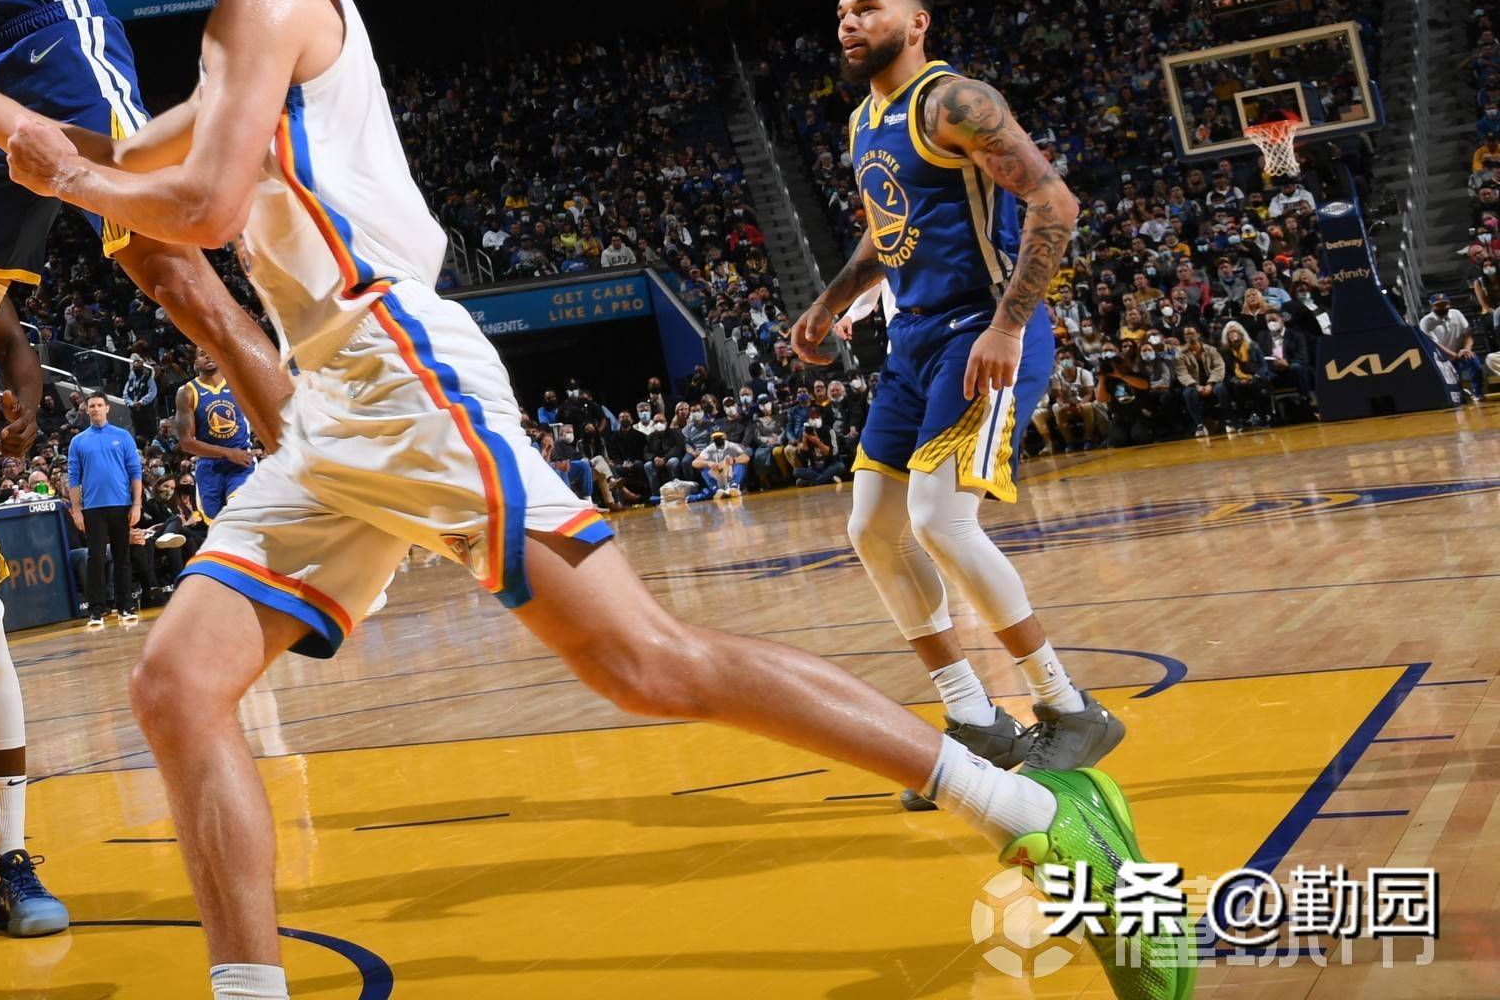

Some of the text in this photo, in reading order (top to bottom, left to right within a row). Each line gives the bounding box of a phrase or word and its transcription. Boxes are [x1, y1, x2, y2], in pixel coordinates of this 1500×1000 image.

[877, 149, 901, 174] STATE
[883, 182, 898, 207] 2
[877, 227, 921, 269] ARRIORS
[1326, 237, 1363, 252] betway
[1333, 266, 1371, 283] xfinity
[552, 284, 635, 306] GET CARE
[549, 298, 645, 322] LIKE A PRO
[225, 409, 232, 419] 9
[29, 504, 50, 513] CHASE
[8, 554, 55, 590] PRO
